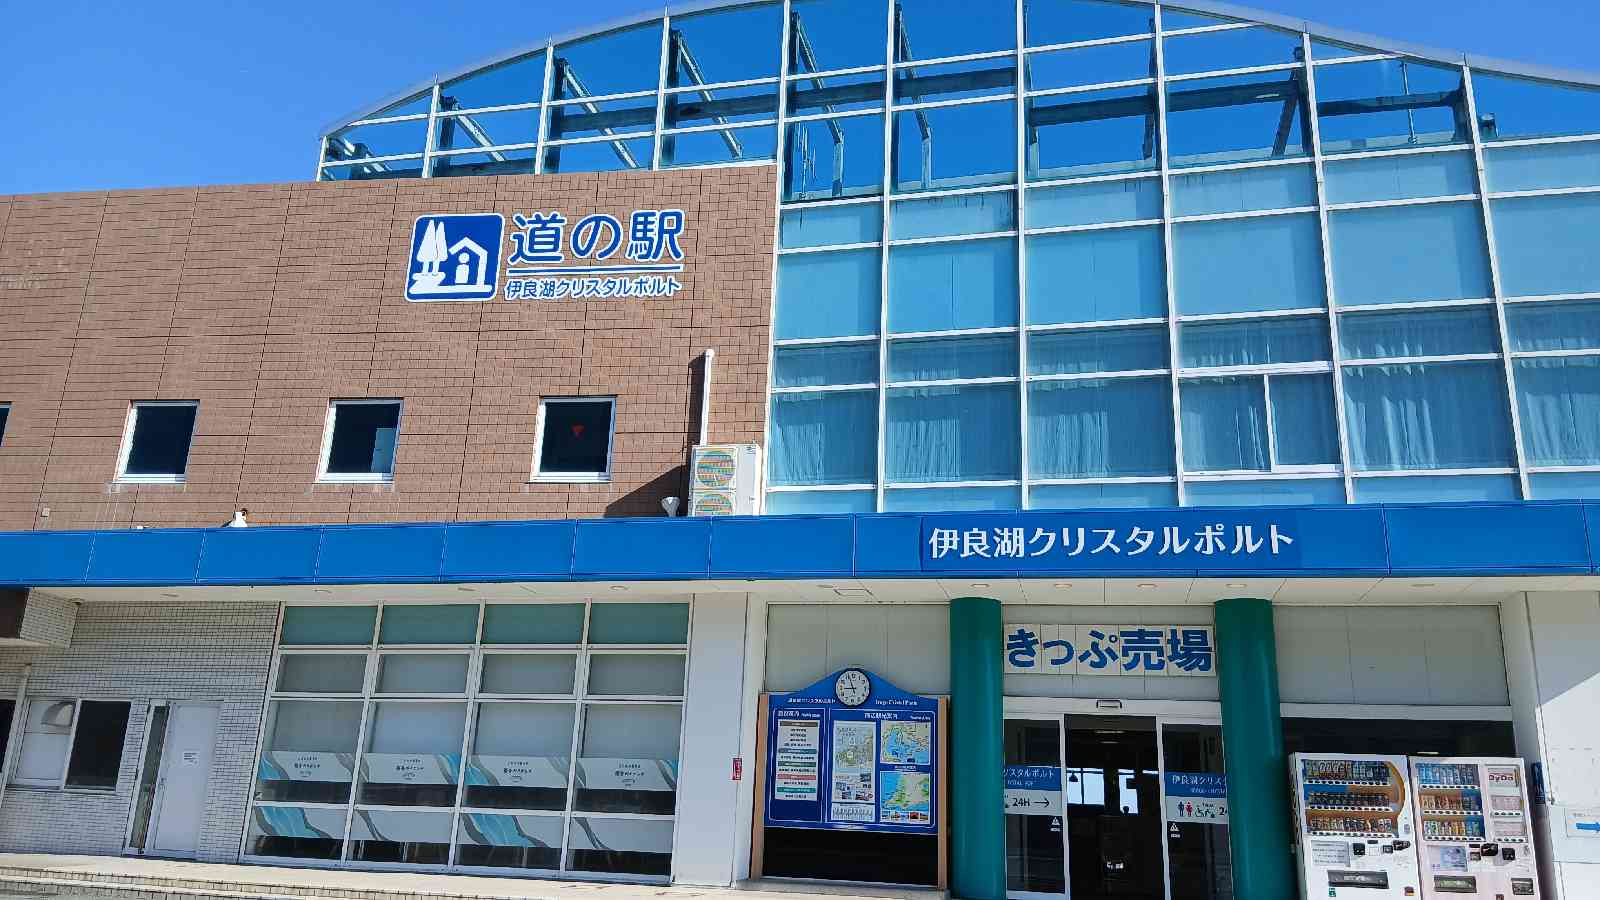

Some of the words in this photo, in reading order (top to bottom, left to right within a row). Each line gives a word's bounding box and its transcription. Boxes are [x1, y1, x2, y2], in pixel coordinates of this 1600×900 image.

[508, 210, 684, 264] 道の駅
[506, 278, 681, 298] 伊良湖クリスタルポルト
[928, 524, 1294, 559] 伊良湖クリスタルポルト
[1006, 627, 1213, 672] きっぷ売場
[1012, 797, 1030, 807] 24H
